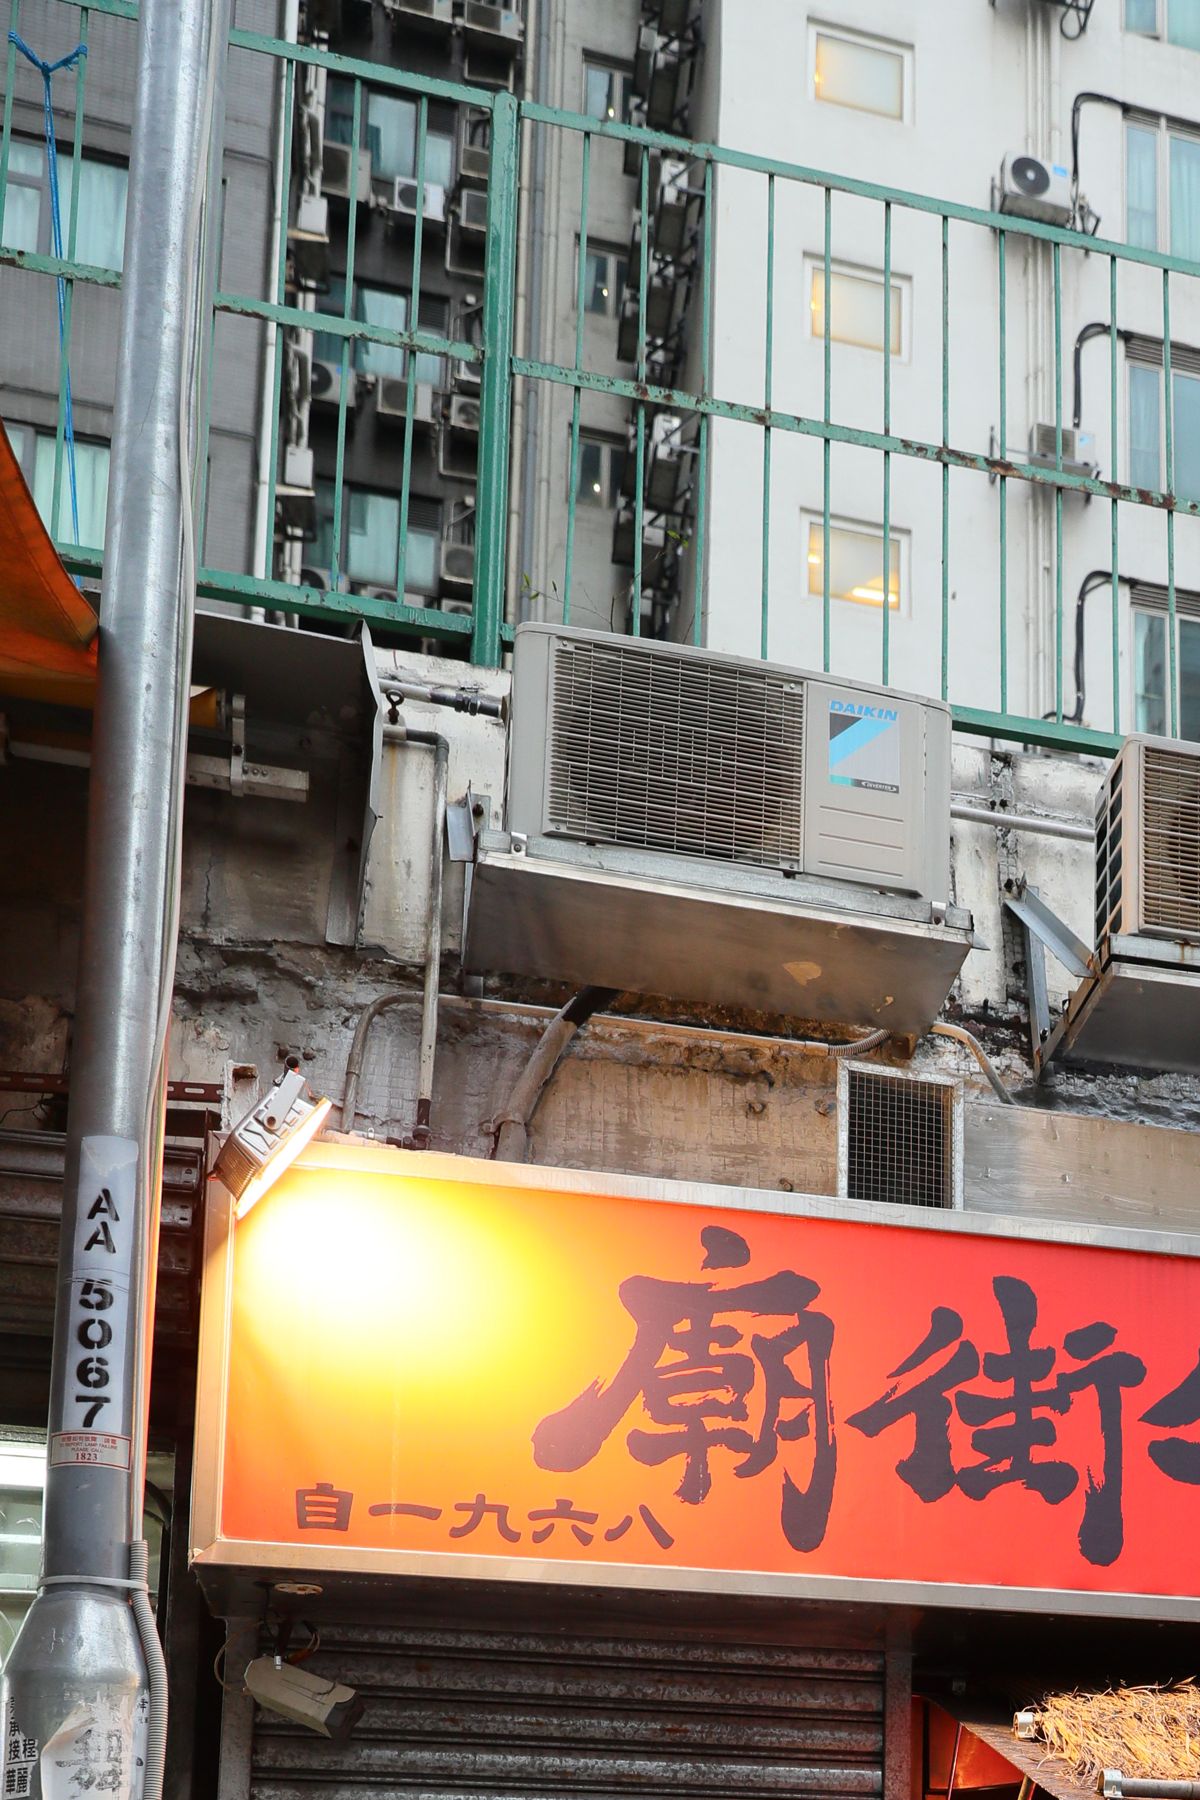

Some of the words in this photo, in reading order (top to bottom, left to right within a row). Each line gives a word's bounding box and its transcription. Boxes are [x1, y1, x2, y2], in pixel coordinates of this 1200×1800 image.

[830, 700, 898, 721] DAIKIN
[75, 1453, 98, 1461] 1823
[295, 1482, 676, 1550] 自一九六八
